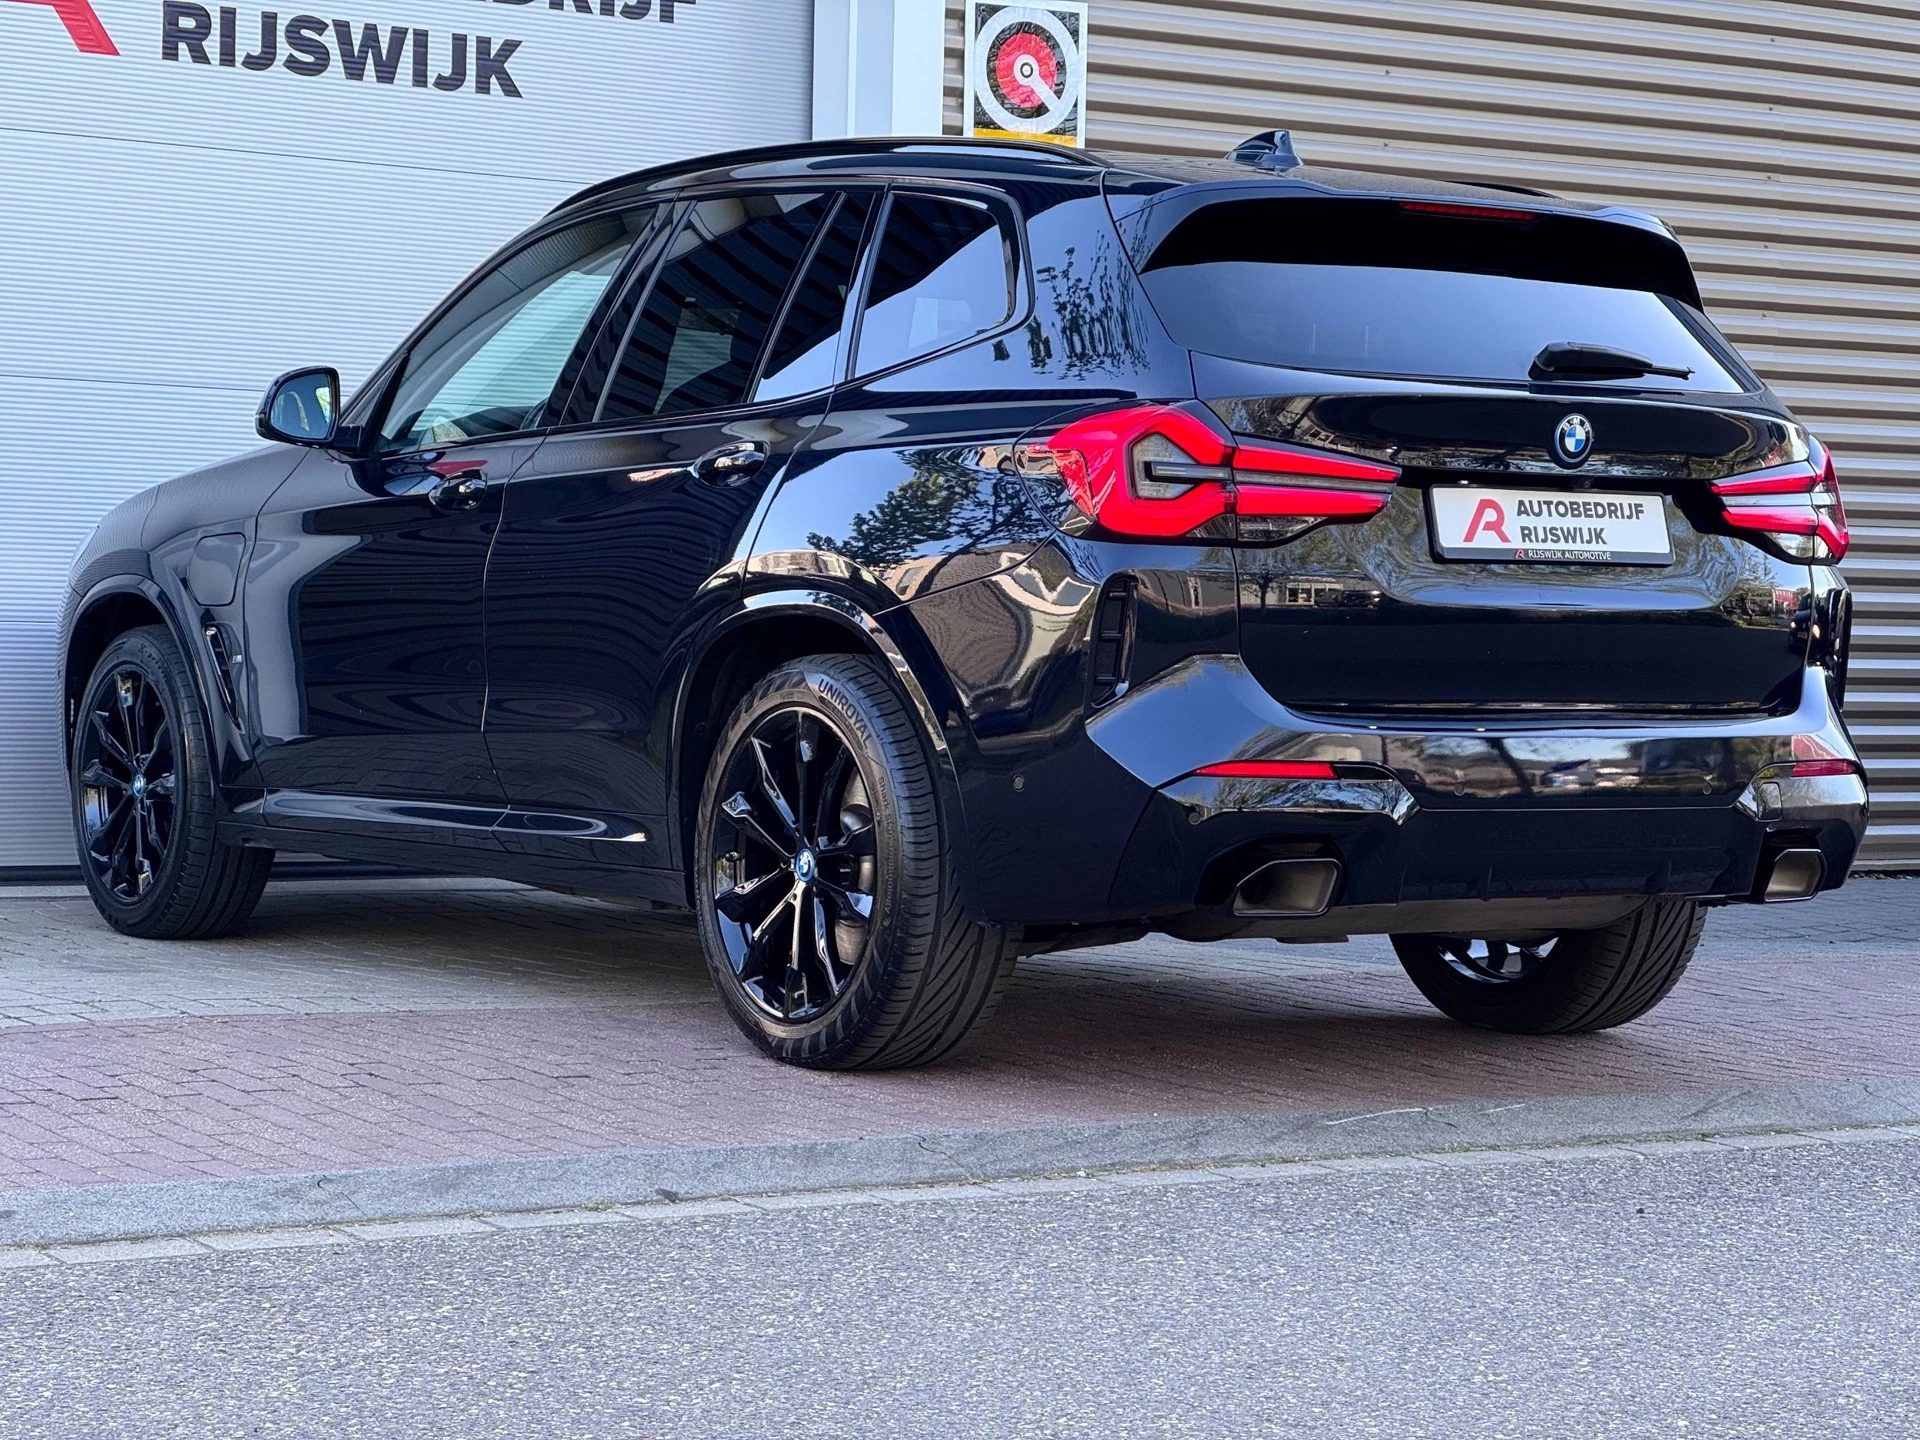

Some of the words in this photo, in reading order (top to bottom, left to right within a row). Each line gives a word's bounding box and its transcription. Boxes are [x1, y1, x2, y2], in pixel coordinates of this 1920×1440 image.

[161, 1, 523, 98] RIJSWIJK
[1516, 500, 1645, 520] AUTOBEDRIJF
[1520, 525, 1608, 545] RIJSWIJK
[1528, 549, 1562, 559] RIJSWIJK
[1564, 551, 1612, 560] AUTOMOTIVE
[817, 679, 873, 750] UNIROYAL
